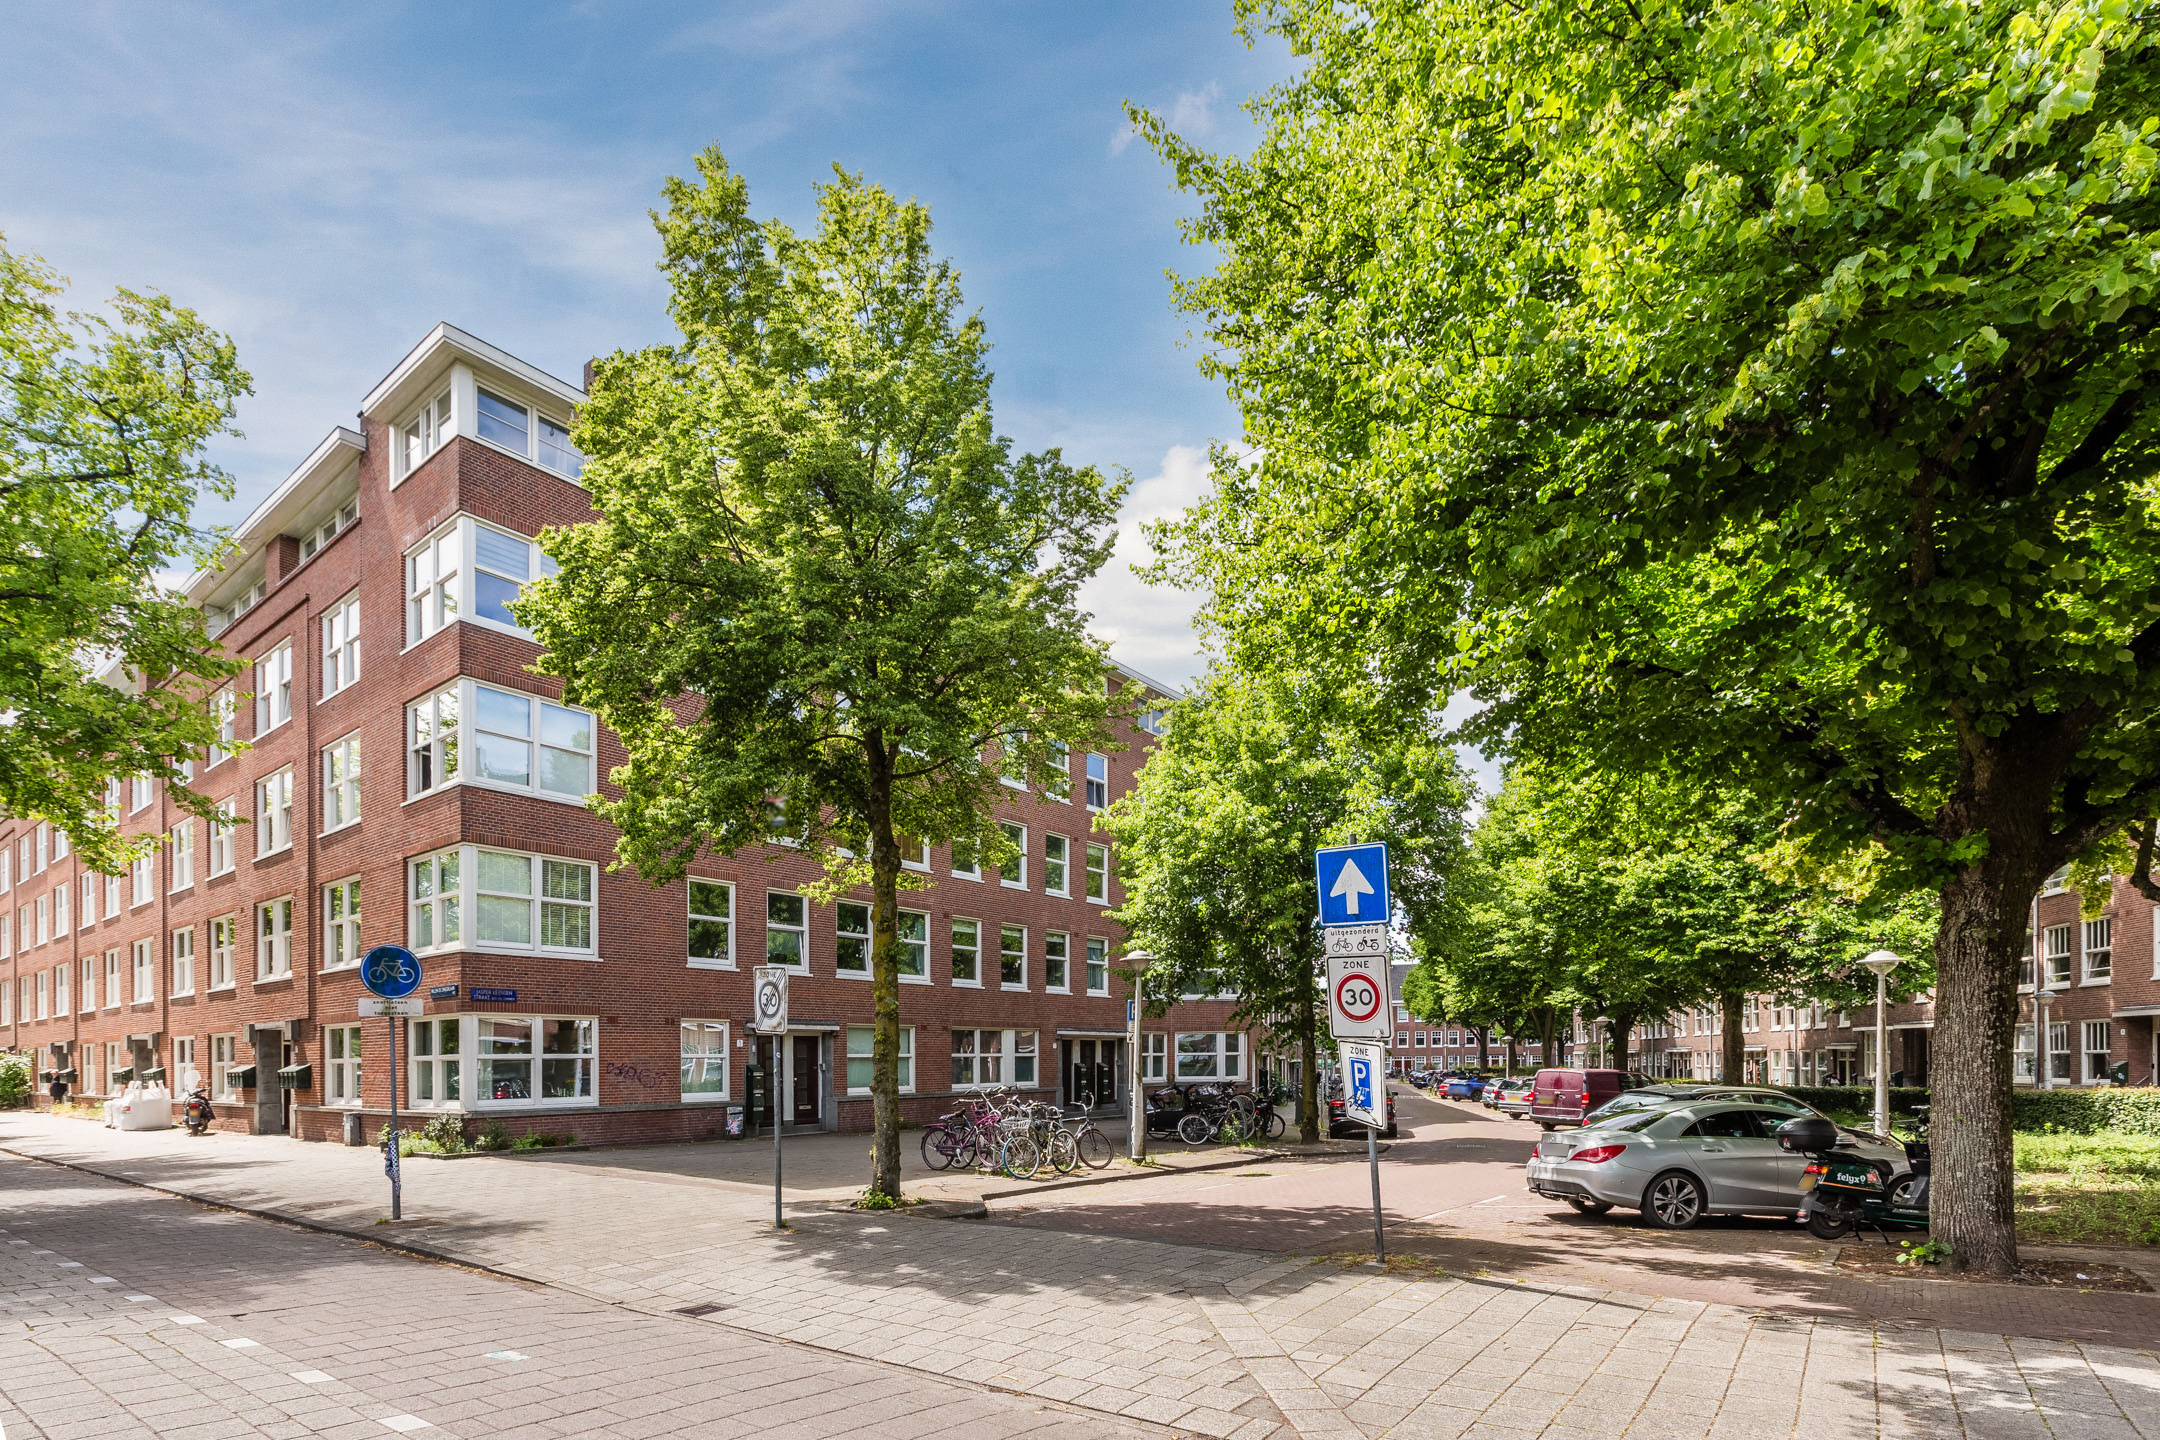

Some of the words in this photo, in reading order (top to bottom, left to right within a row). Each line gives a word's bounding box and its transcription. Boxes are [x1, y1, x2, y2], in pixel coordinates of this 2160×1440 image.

[1330, 928, 1379, 937] uitgezonderd
[1343, 961, 1370, 969] ZONE
[763, 993, 778, 1007] 30
[1345, 988, 1373, 1006] 30
[1350, 1047, 1369, 1056] ZONE
[1354, 1062, 1367, 1087] P
[1837, 1172, 1860, 1184] felyx
